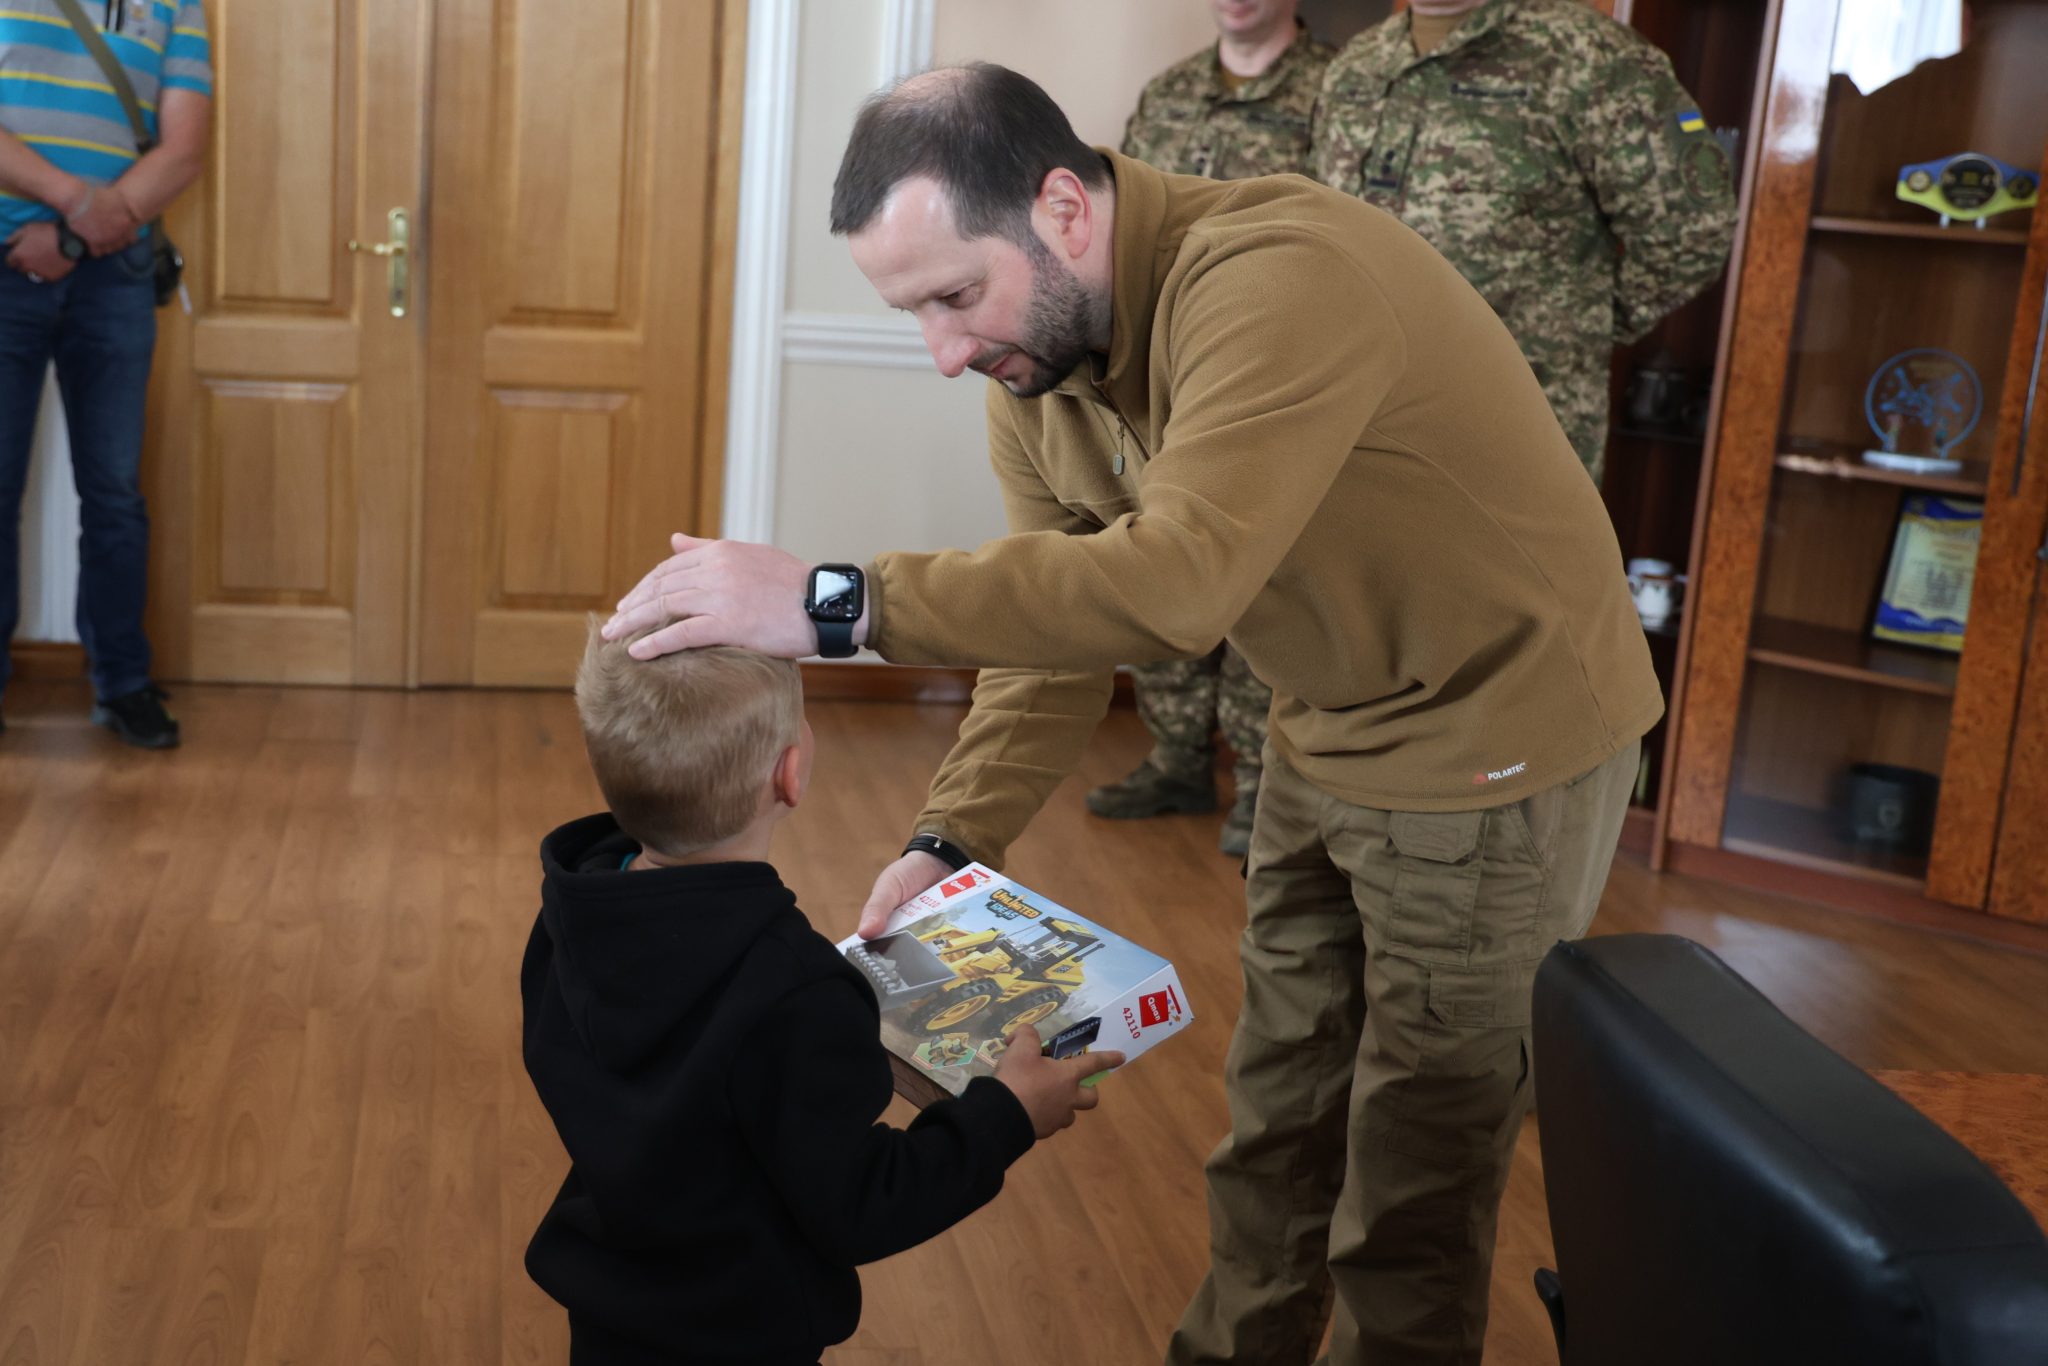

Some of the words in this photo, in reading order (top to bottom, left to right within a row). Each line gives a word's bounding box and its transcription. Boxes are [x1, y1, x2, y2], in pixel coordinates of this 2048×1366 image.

[1487, 763, 1525, 781] POLARTEC
[1148, 997, 1161, 1021] Qman
[1123, 1007, 1141, 1039] 42110
